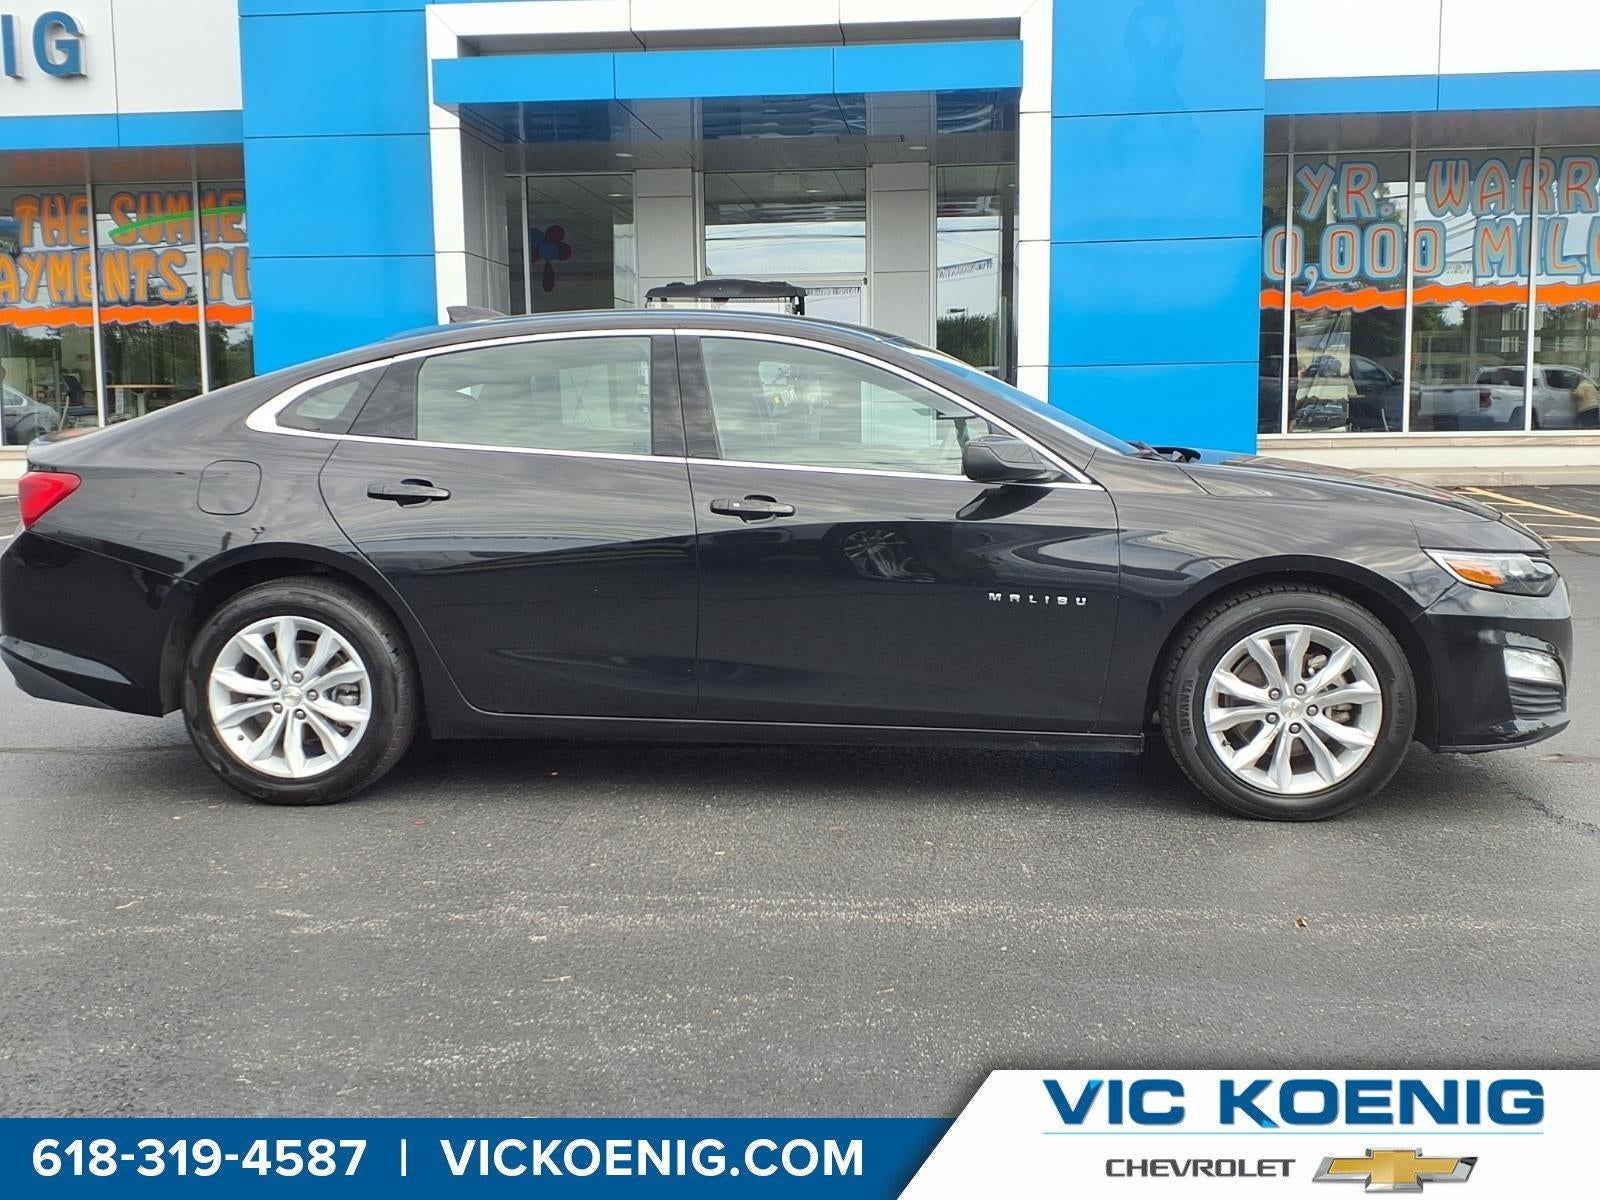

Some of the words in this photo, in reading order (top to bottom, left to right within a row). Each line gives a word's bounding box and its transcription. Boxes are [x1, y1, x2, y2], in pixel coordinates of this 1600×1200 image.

[1425, 156, 1600, 217] WARR
[13, 193, 91, 247] THE
[0, 248, 188, 303] AYMENTS
[988, 592, 1088, 606] MALIBU
